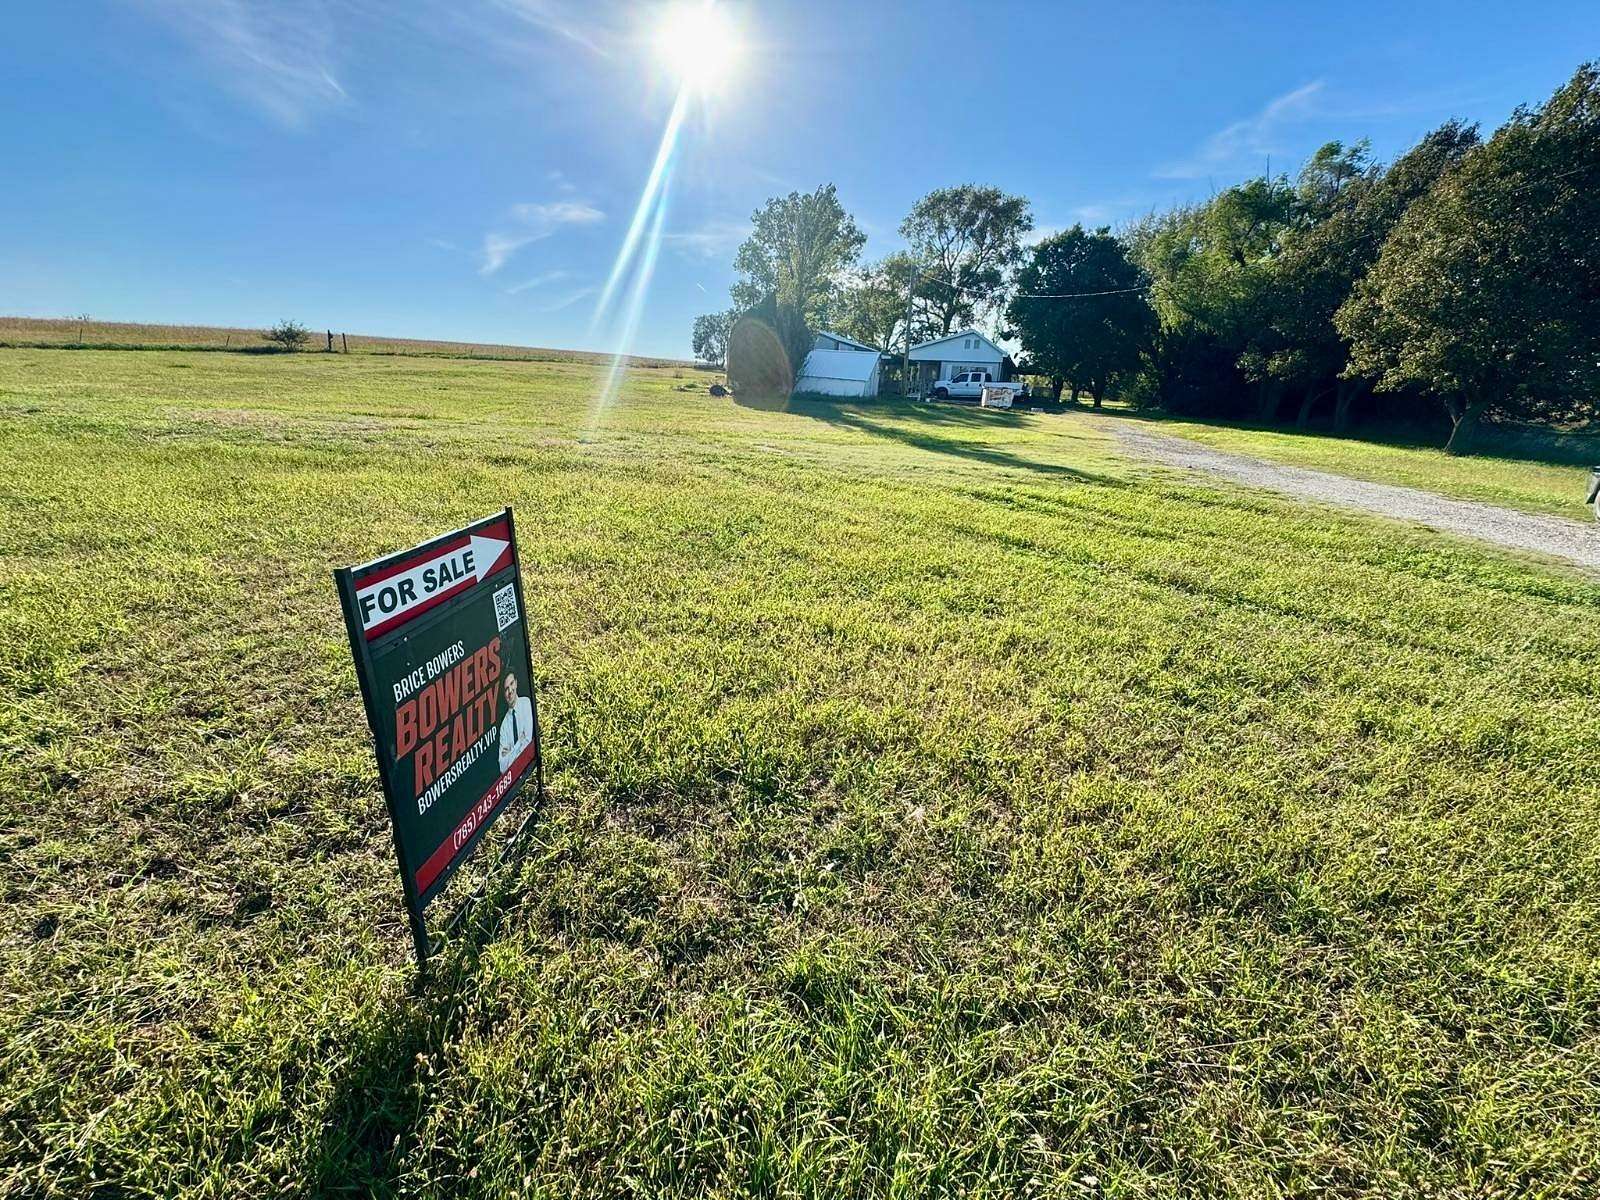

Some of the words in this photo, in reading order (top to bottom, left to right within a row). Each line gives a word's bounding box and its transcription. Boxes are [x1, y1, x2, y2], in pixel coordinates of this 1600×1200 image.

[358, 578, 417, 624] FOR
[422, 550, 476, 593] SALE
[392, 666, 427, 702] BRICE
[425, 640, 465, 679] BOWERS
[396, 637, 501, 759] BOWERS
[414, 681, 500, 797] REALTY
[417, 725, 497, 815] BOWERSREALTY.VIP
[453, 812, 477, 850] (785)
